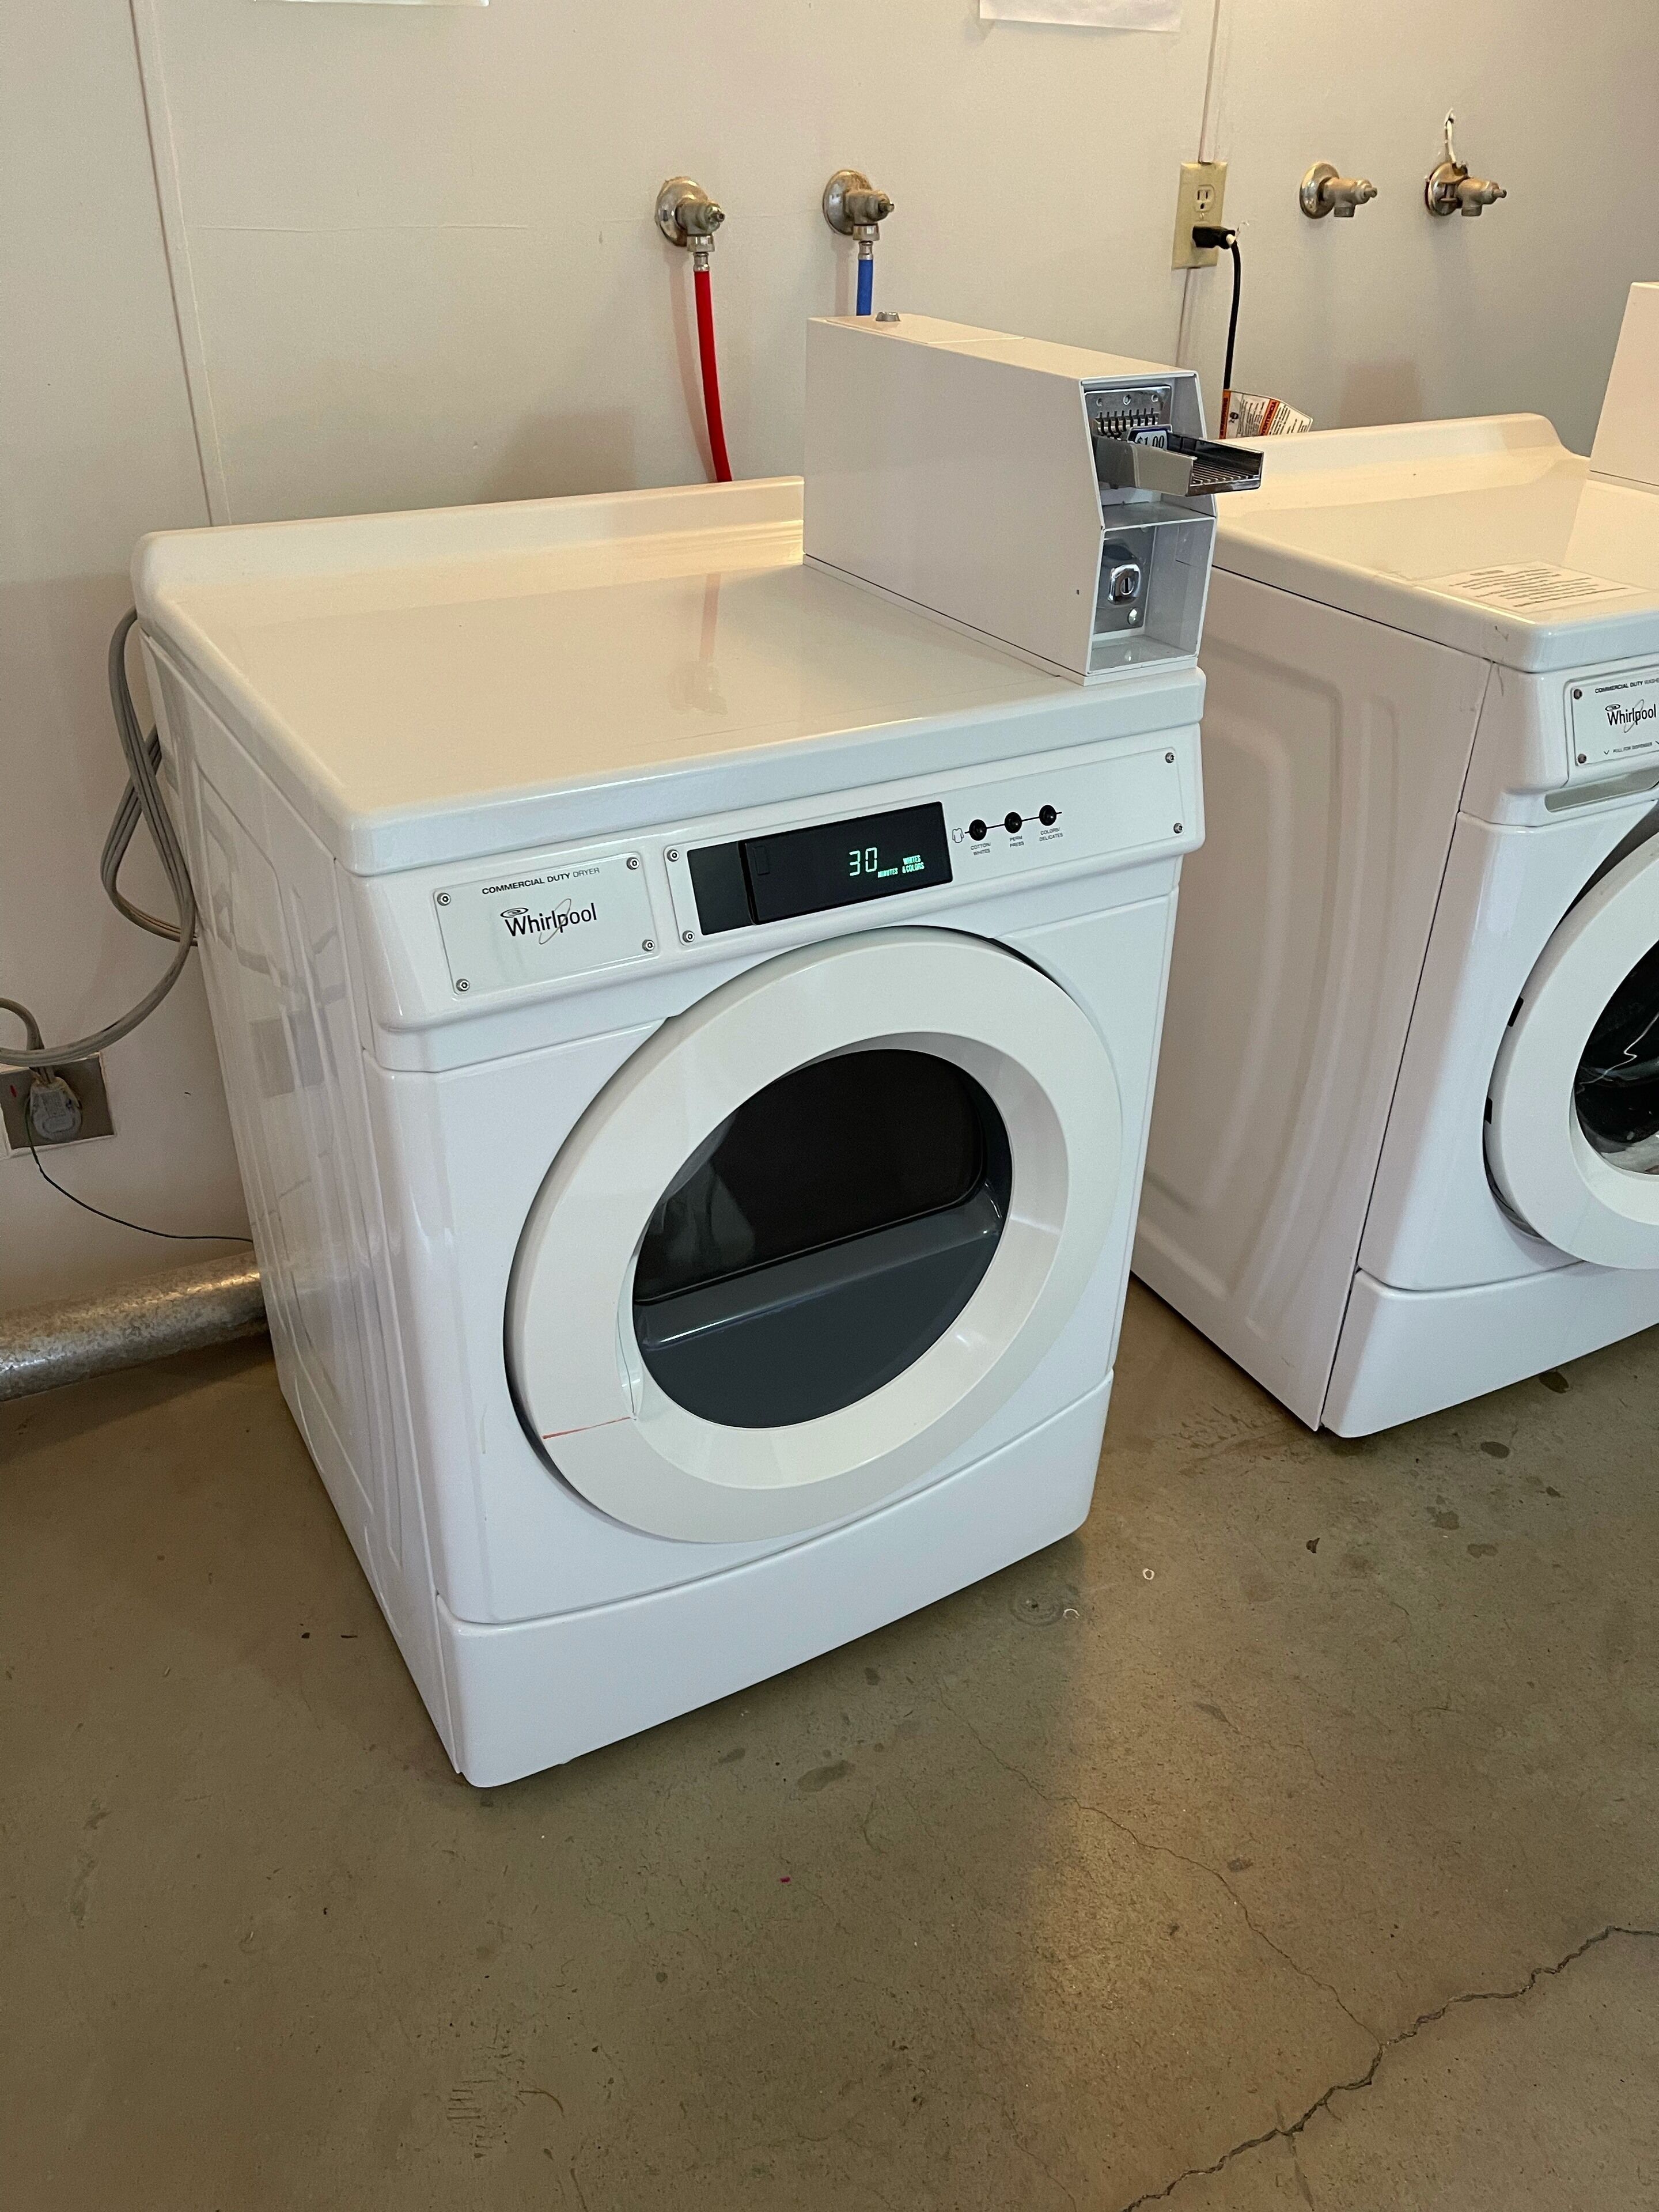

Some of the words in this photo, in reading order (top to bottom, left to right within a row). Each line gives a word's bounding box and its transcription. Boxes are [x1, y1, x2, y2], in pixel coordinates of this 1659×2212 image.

[1137, 435, 1165, 448] $100
[1607, 703, 1657, 726] Whirlpool
[1039, 832, 1064, 842] DELICATES
[849, 847, 877, 876] 30
[482, 878, 545, 895] COMMERCIAL
[547, 873, 571, 882] DUTY
[573, 867, 600, 878] DRYER
[505, 903, 597, 937] Whirlpool
